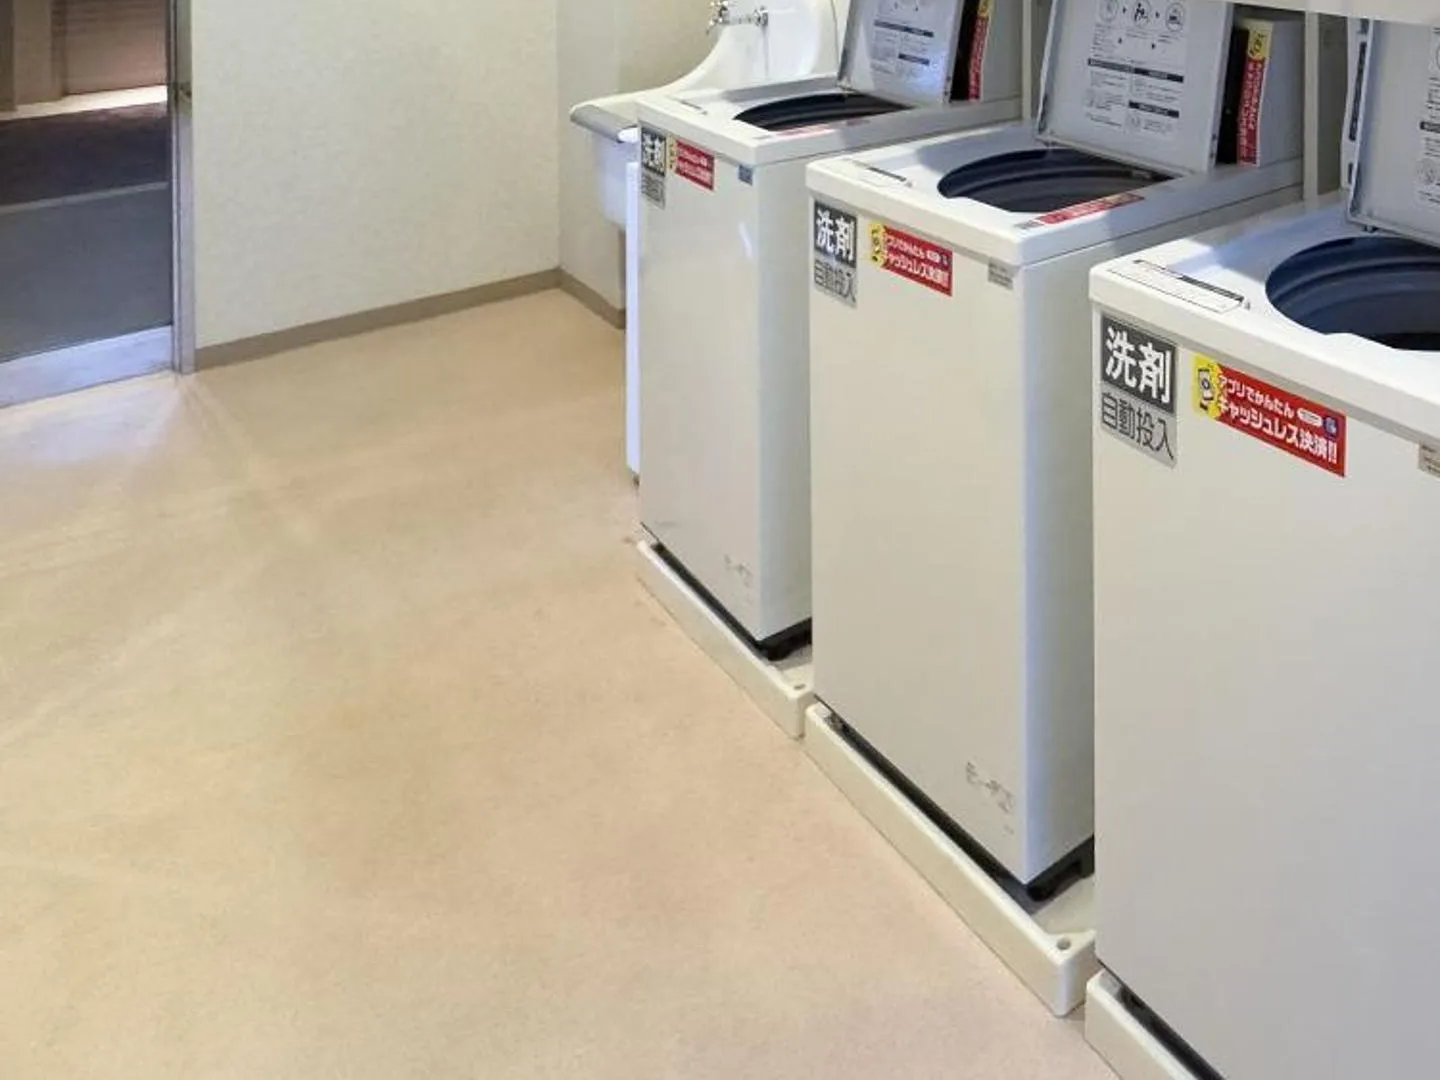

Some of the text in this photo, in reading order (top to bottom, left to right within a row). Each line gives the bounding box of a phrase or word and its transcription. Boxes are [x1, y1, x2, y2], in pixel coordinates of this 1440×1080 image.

[816, 207, 854, 262] 洗剤
[1105, 325, 1172, 404] 洗剤
[1218, 375, 1295, 418] アプリでかんたん
[1101, 392, 1175, 461] 自動投入
[1217, 397, 1338, 465] キャッシュレス決済!!
